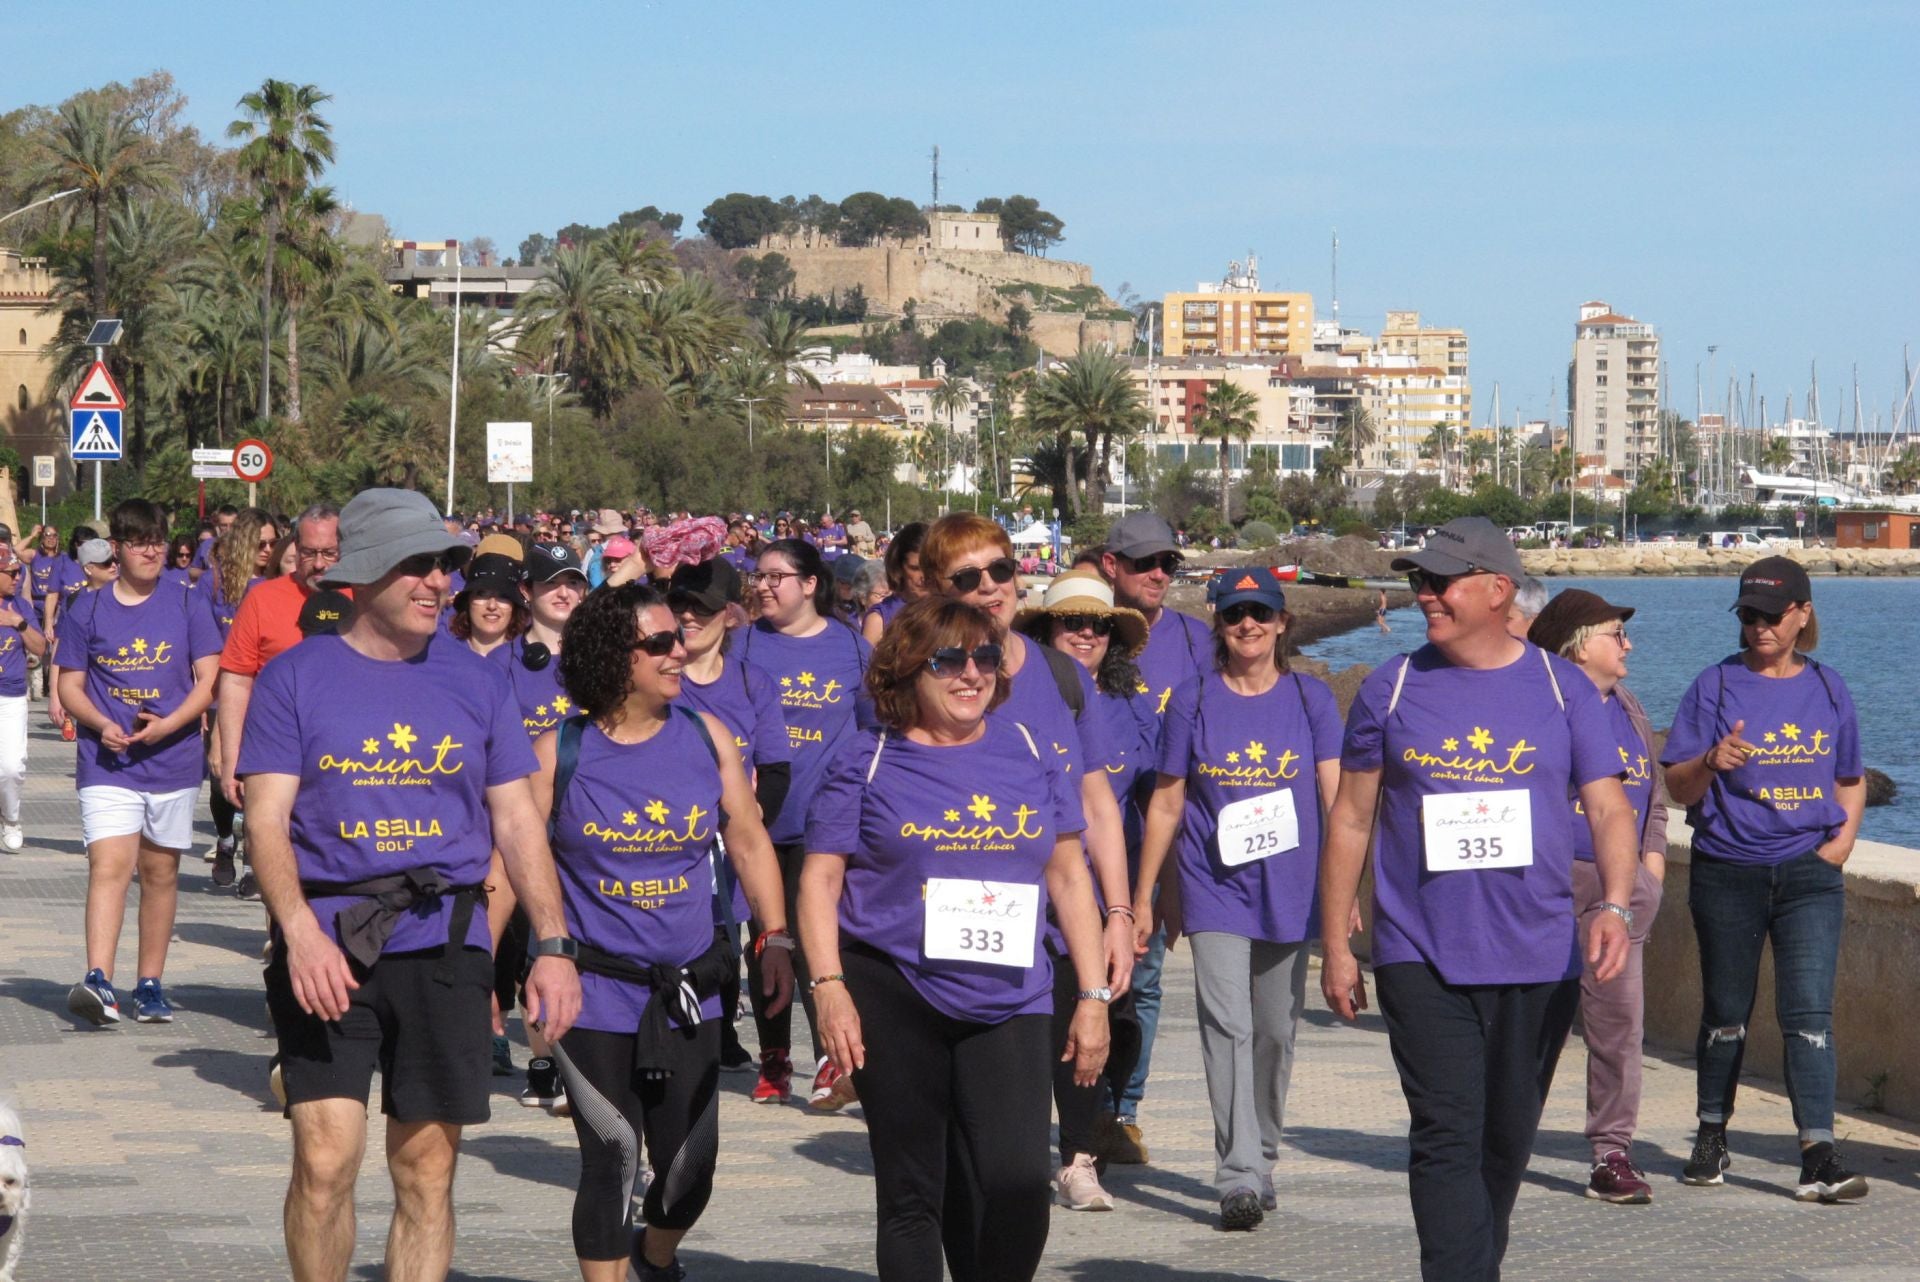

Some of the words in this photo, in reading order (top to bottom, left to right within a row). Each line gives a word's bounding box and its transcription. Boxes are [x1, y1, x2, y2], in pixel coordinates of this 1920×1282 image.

[240, 453, 263, 467] 50
[97, 641, 172, 666] amunt
[781, 679, 842, 703] unt
[790, 740, 801, 748] LF
[1741, 729, 1830, 757] munt
[319, 735, 463, 774] amunt
[1198, 749, 1299, 779] amunt
[1403, 739, 1536, 774] amunt
[352, 776, 384, 786] contra
[387, 774, 397, 786] el
[1218, 779, 1242, 787] contra
[1244, 778, 1253, 787] el
[1430, 771, 1461, 780] contra
[1463, 771, 1473, 781] el
[1773, 787, 1823, 800] SELLA
[1776, 801, 1800, 810] GOLF
[583, 805, 708, 842] amunt
[901, 804, 1042, 841] amunt
[1436, 806, 1516, 827] amunt
[340, 821, 369, 839] LA
[375, 819, 443, 837] SELLA
[376, 840, 414, 852] GOLF
[612, 844, 642, 853] contra
[644, 843, 653, 852] el
[935, 841, 967, 851] contra
[971, 840, 980, 850] el
[1244, 830, 1278, 854] 225
[1457, 836, 1503, 860] 335
[600, 879, 625, 897] LA
[631, 875, 689, 897] SELLA
[959, 927, 1004, 953] 333
